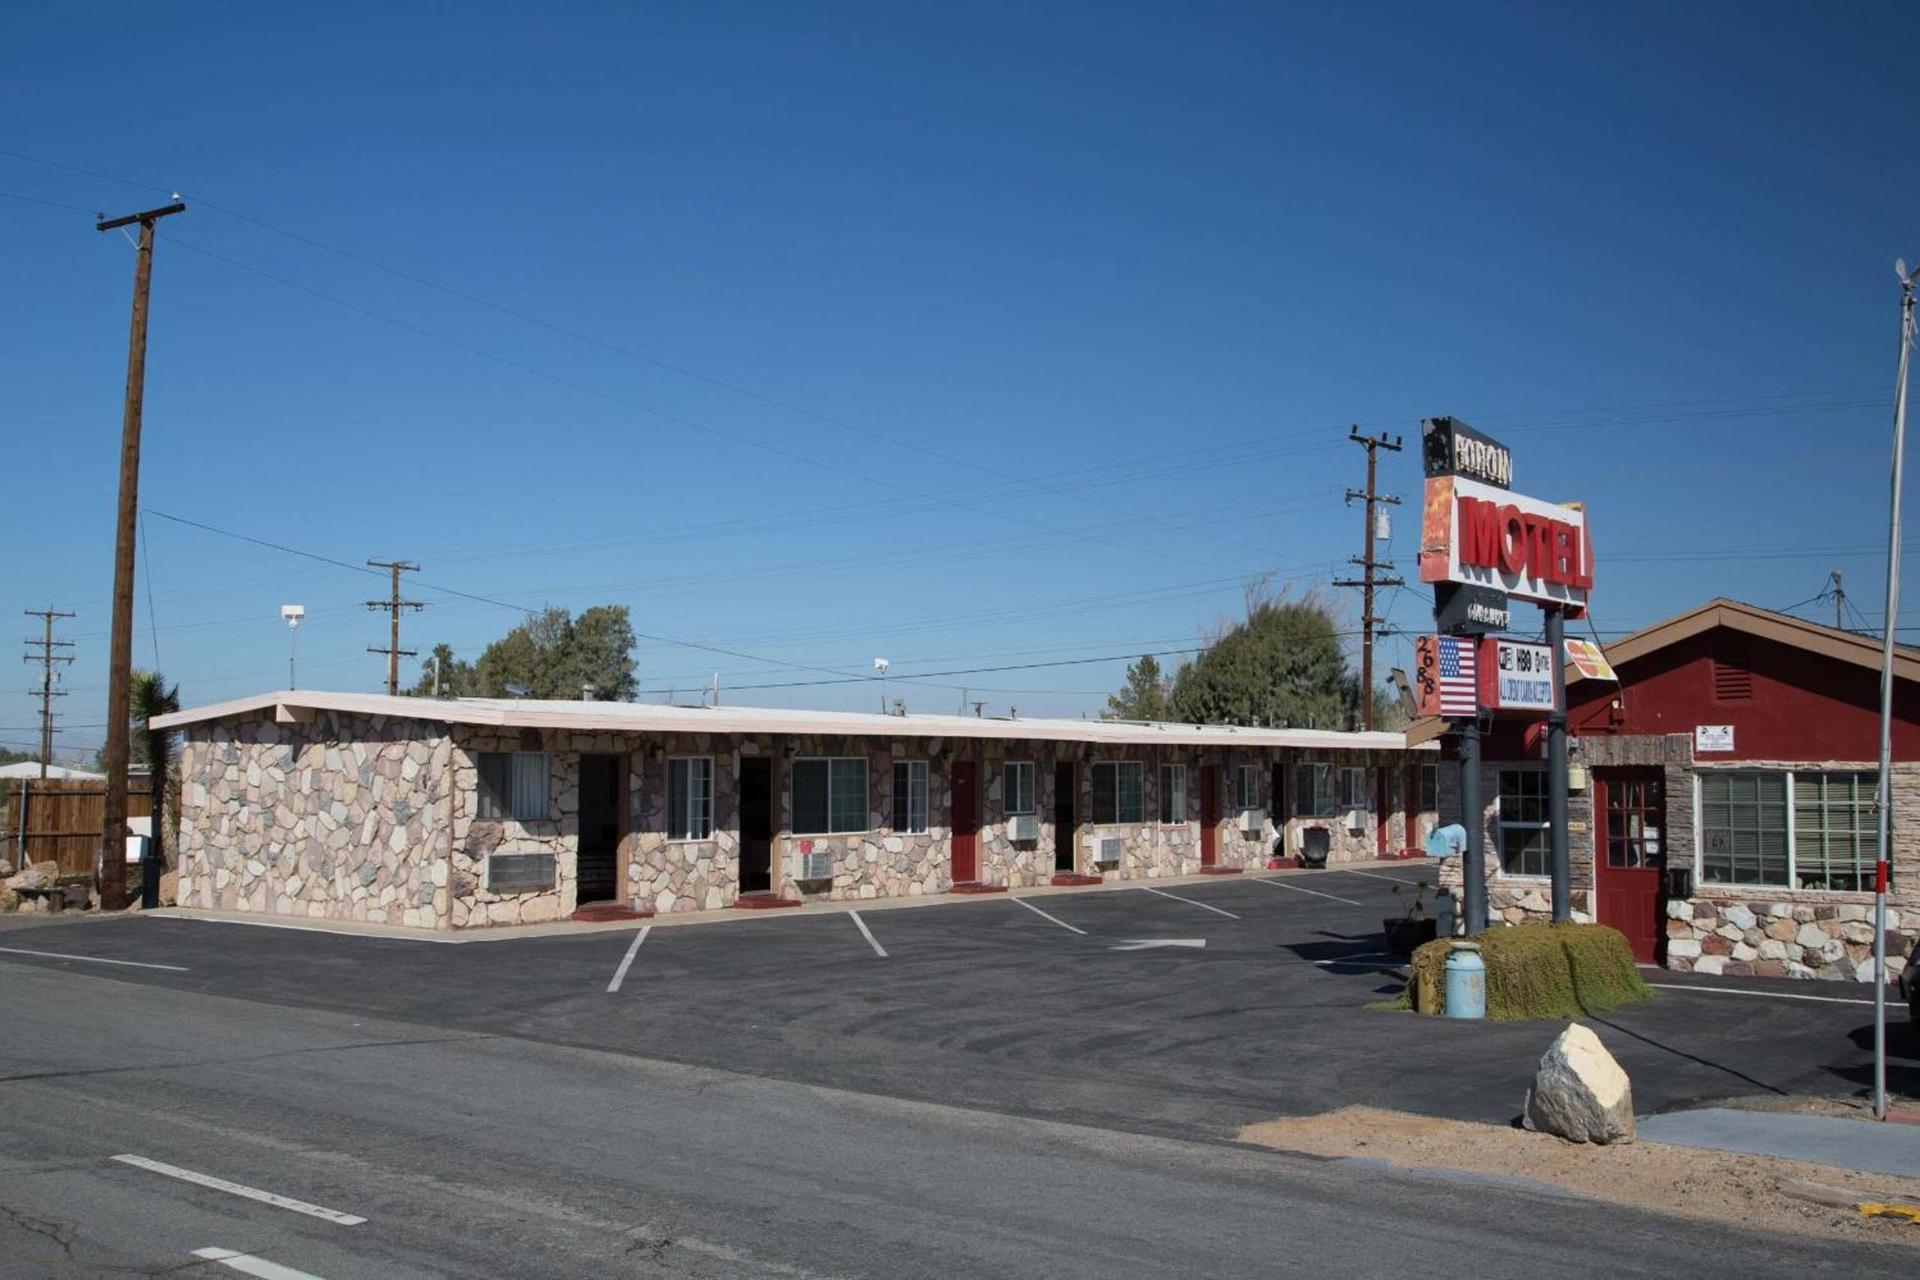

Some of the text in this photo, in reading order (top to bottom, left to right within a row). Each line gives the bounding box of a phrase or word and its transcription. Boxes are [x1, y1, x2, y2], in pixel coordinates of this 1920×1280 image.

[1455, 433, 1512, 485] BORON
[1458, 496, 1592, 589] MOTEL
[1517, 648, 1531, 672] HBO
